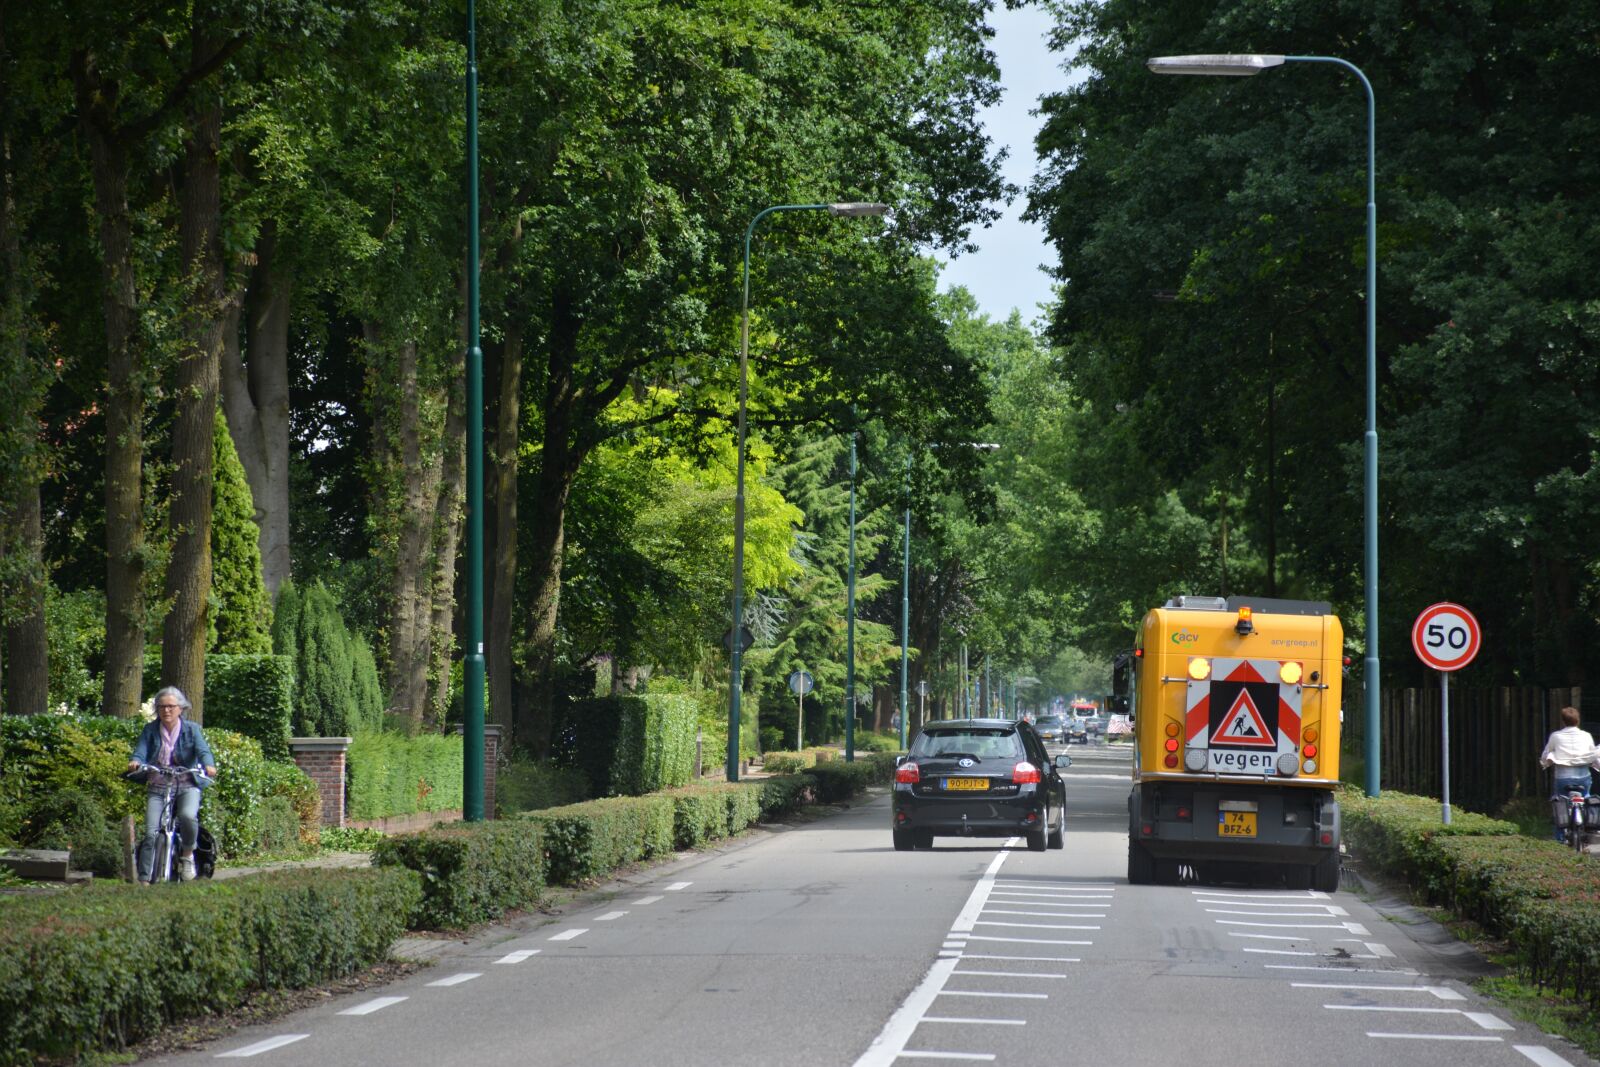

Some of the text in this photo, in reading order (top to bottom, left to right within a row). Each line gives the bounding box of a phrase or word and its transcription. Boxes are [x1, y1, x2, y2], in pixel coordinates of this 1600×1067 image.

[1178, 633, 1199, 642] acv
[1427, 625, 1467, 649] 50
[1271, 639, 1318, 647] acv-groep.nl
[1213, 753, 1272, 770] vegen
[950, 779, 985, 788] 90-PJT-2
[1232, 813, 1245, 823] 74
[1223, 824, 1252, 834] BFZ-6
